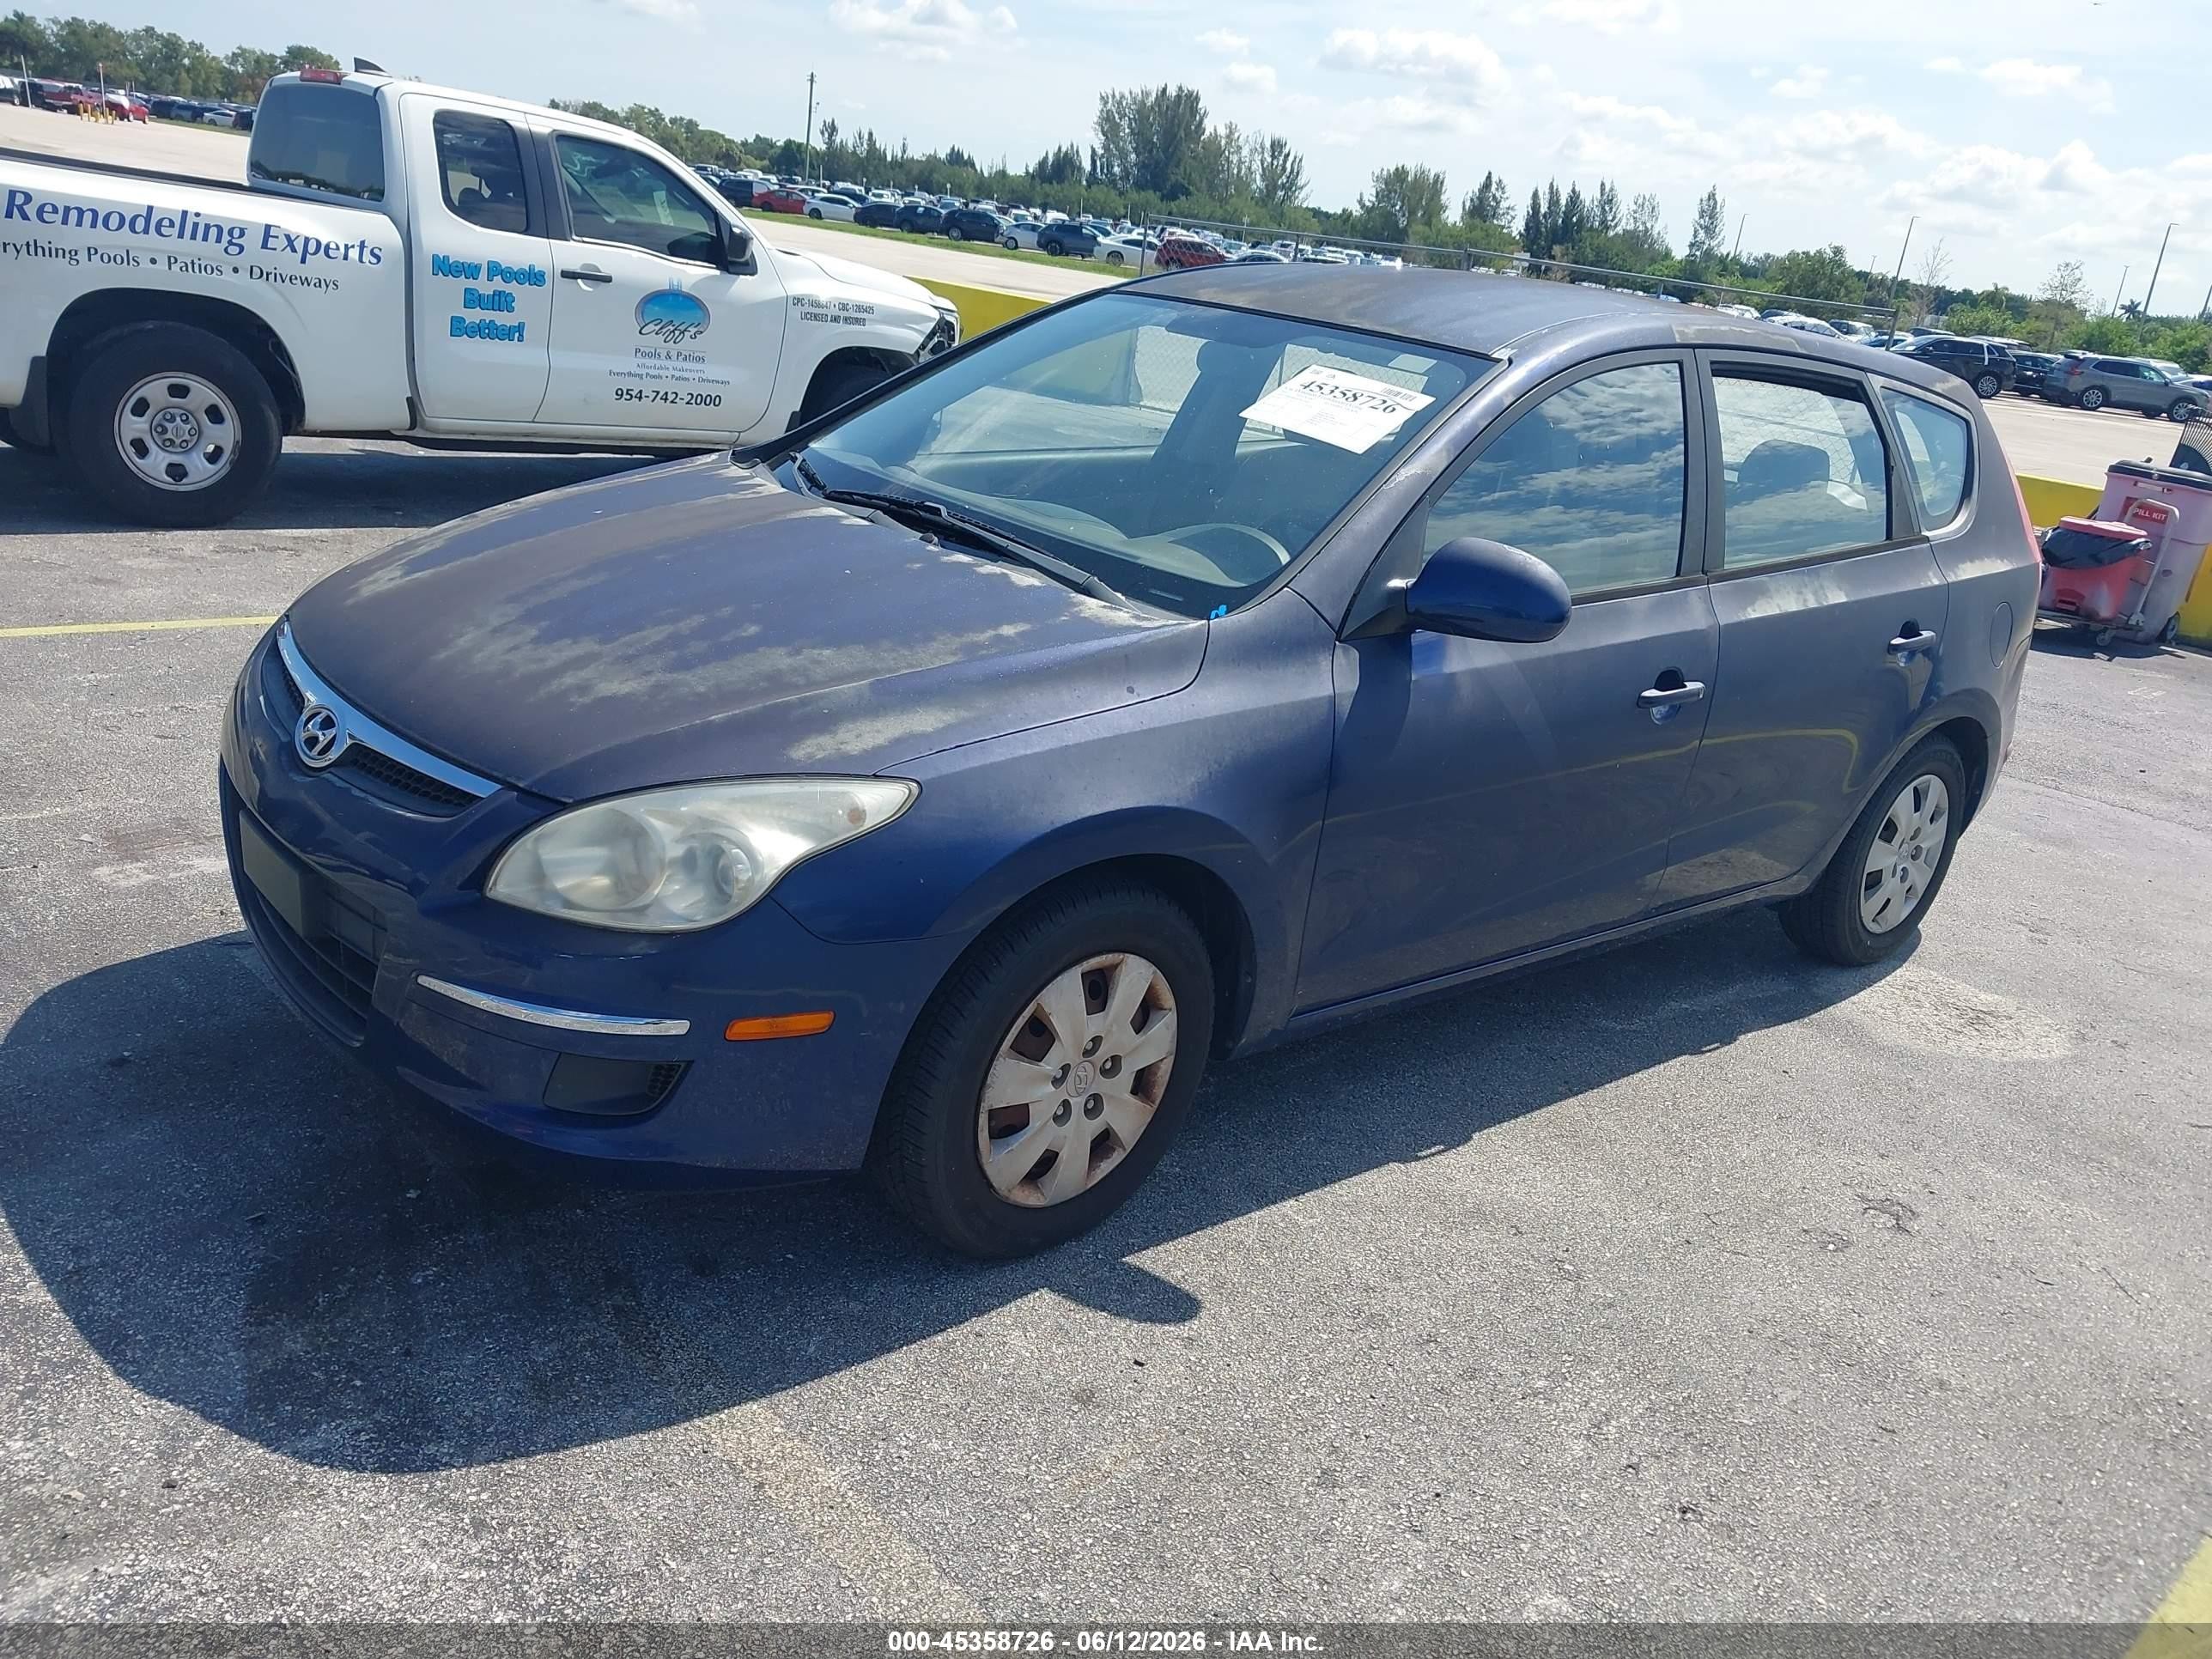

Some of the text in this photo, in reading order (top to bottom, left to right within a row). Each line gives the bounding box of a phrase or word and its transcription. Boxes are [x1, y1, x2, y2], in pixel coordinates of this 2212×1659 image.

[4, 189, 383, 266] Remodeling Experts
[3, 239, 340, 295] rything Pools Patios Driveways
[432, 254, 546, 287] New Pools
[464, 288, 515, 313] Built
[450, 316, 525, 342] Better!
[638, 318, 703, 344] Cliff's
[799, 311, 866, 327] LICENSED AND INSURED
[635, 347, 706, 363] Pools & Patios
[608, 369, 644, 380] Everything
[697, 377, 730, 386] Driveways
[614, 387, 722, 407] 954-742-2000
[1299, 380, 1397, 414] 45358726
[2133, 507, 2166, 520] PILL KIT
